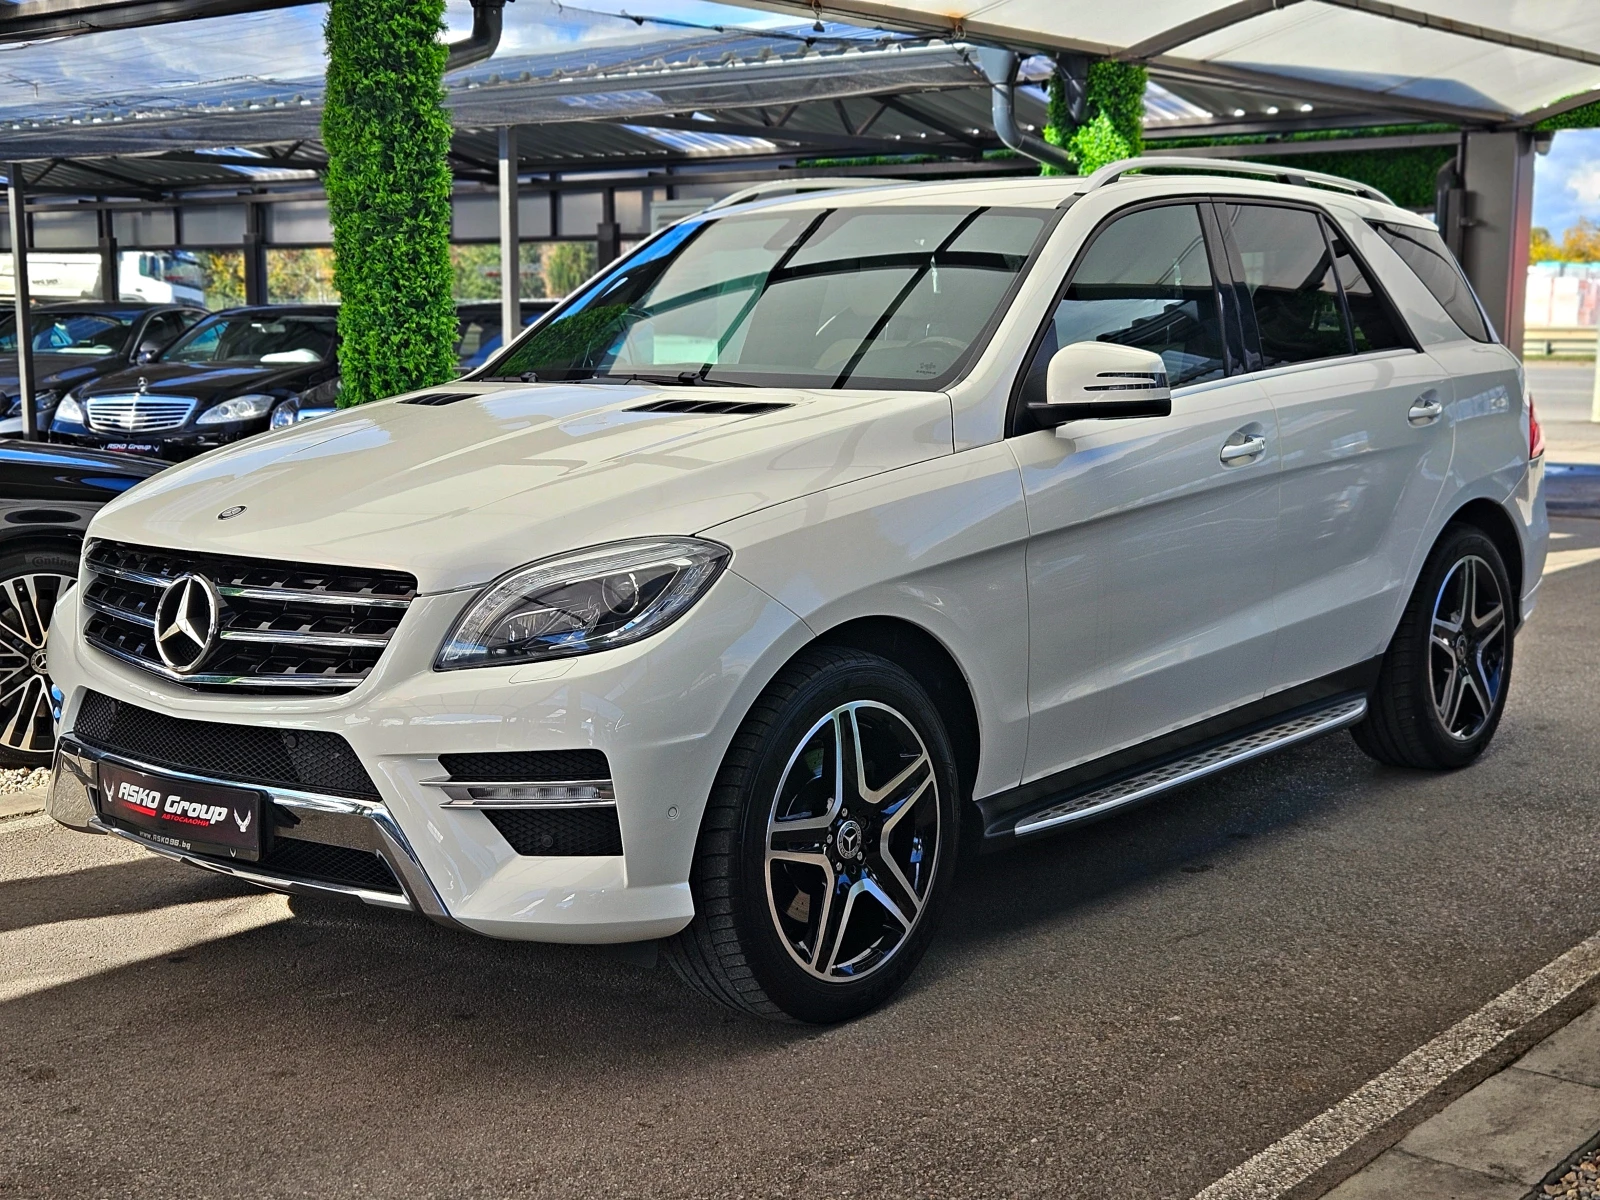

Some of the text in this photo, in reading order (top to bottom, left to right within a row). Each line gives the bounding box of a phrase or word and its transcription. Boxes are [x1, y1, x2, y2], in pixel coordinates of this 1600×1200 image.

[118, 781, 228, 825] ASKO Group
[161, 813, 209, 827] АВТОСАЛОНИ
